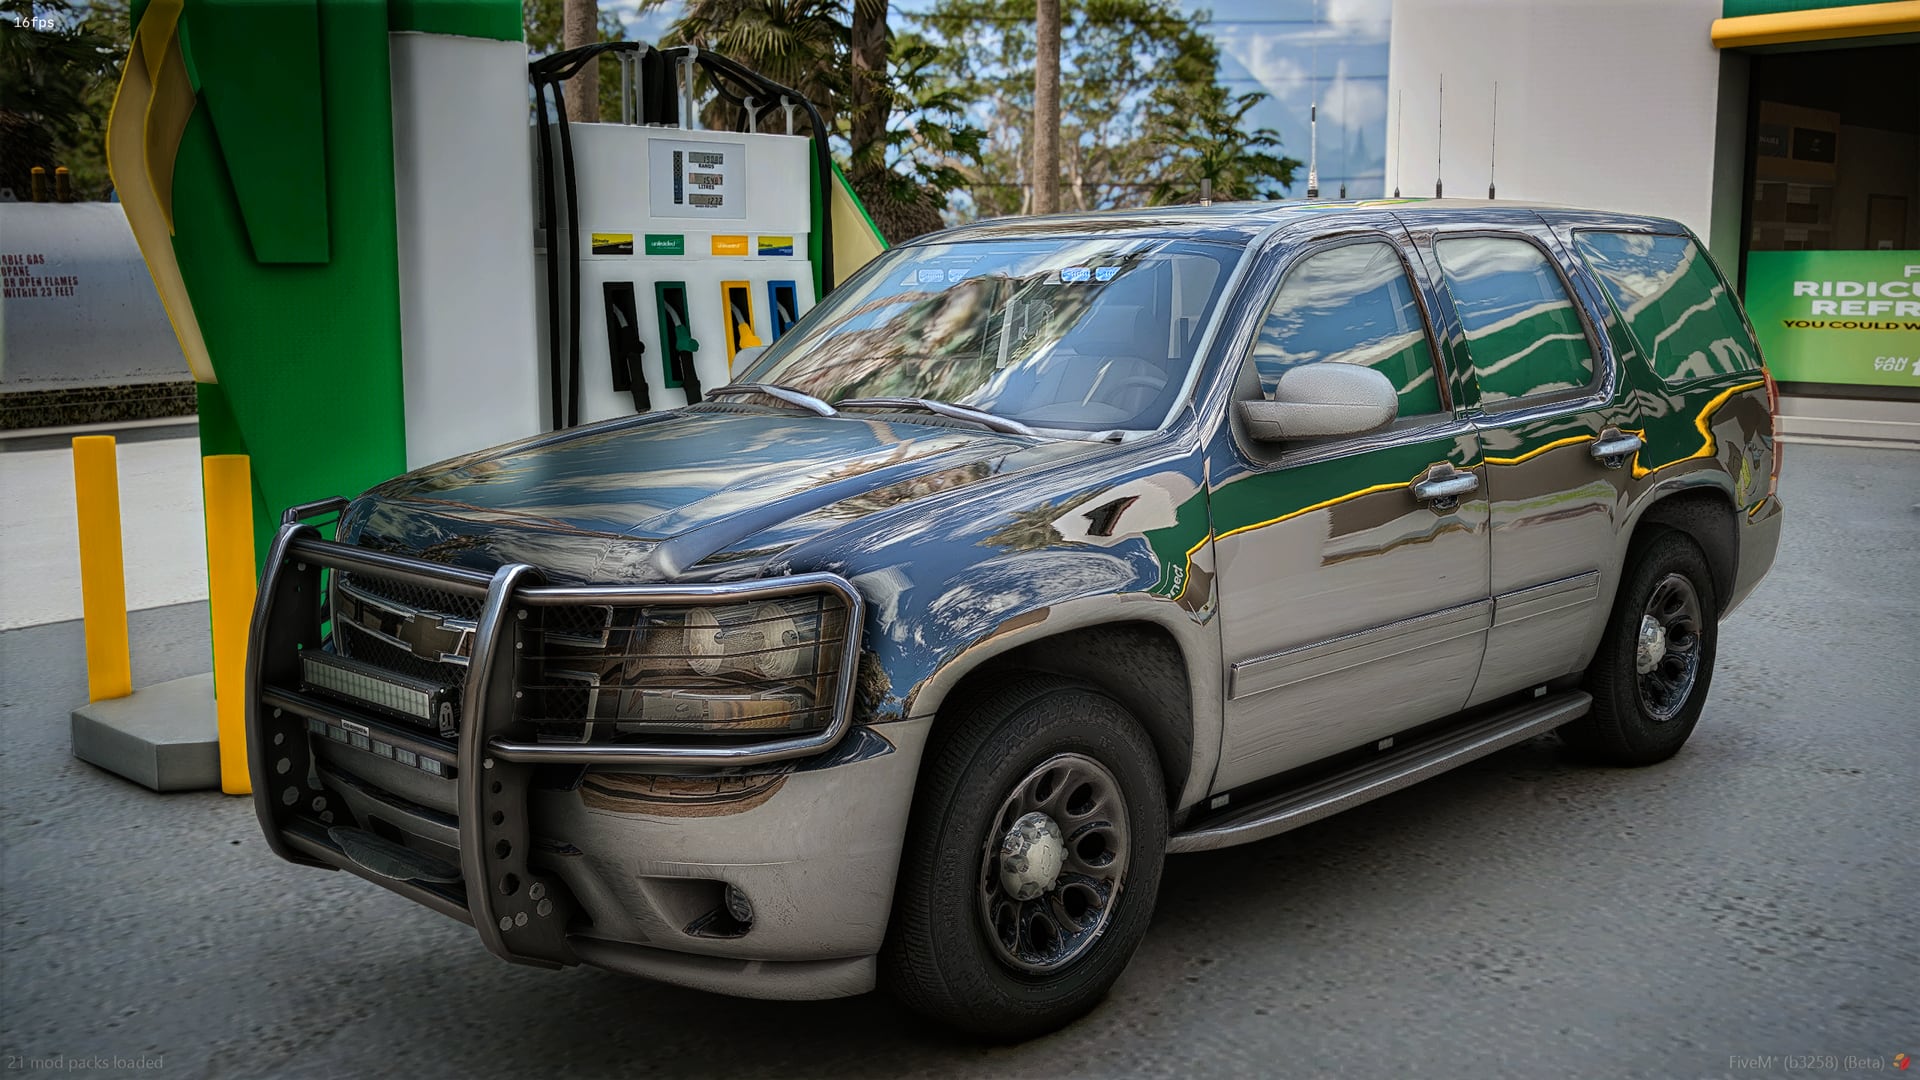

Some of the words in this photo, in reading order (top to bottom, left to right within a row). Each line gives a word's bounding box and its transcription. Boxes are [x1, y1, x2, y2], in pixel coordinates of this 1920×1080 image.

[26, 254, 45, 265] GAS
[3, 277, 16, 287] OR
[19, 277, 42, 287] OPEN
[45, 276, 79, 287] FLAMES
[41, 287, 52, 297] 23
[55, 286, 75, 297] FEET
[1811, 300, 1920, 317] REFR
[1783, 320, 1825, 328] YOU
[1829, 321, 1899, 330] COULD
[1873, 363, 1906, 372] YOU
